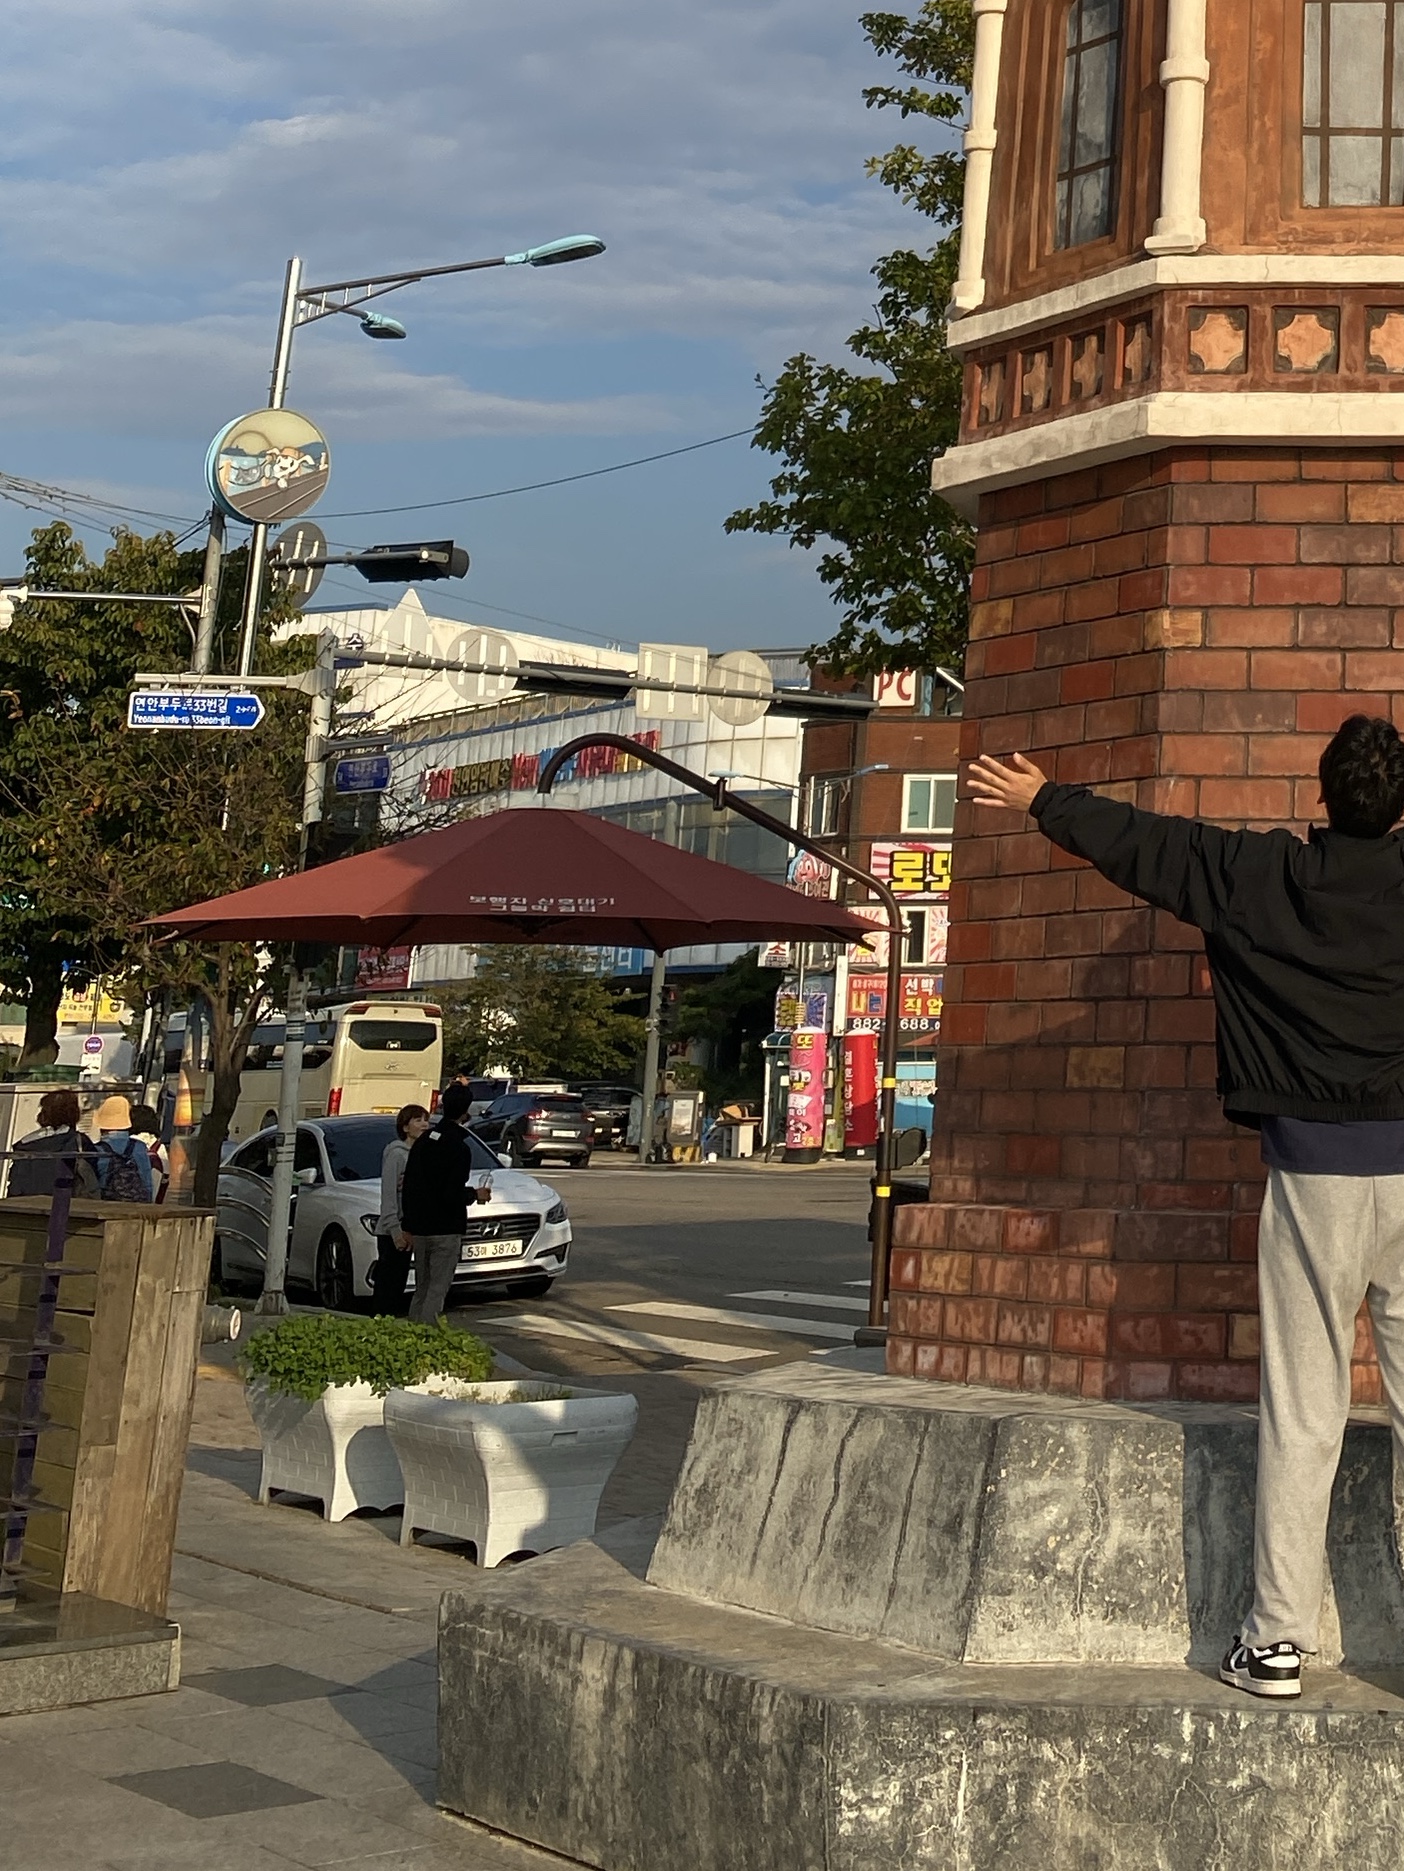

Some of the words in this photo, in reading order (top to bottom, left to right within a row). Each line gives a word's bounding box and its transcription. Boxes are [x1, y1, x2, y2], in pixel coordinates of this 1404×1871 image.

[878, 670, 912, 702] PC
[134, 697, 228, 714] 연안부두로33번길
[133, 713, 190, 724] Yeonanbudu-ro
[469, 895, 527, 905] 보행자
[537, 896, 615, 905] 신호대기
